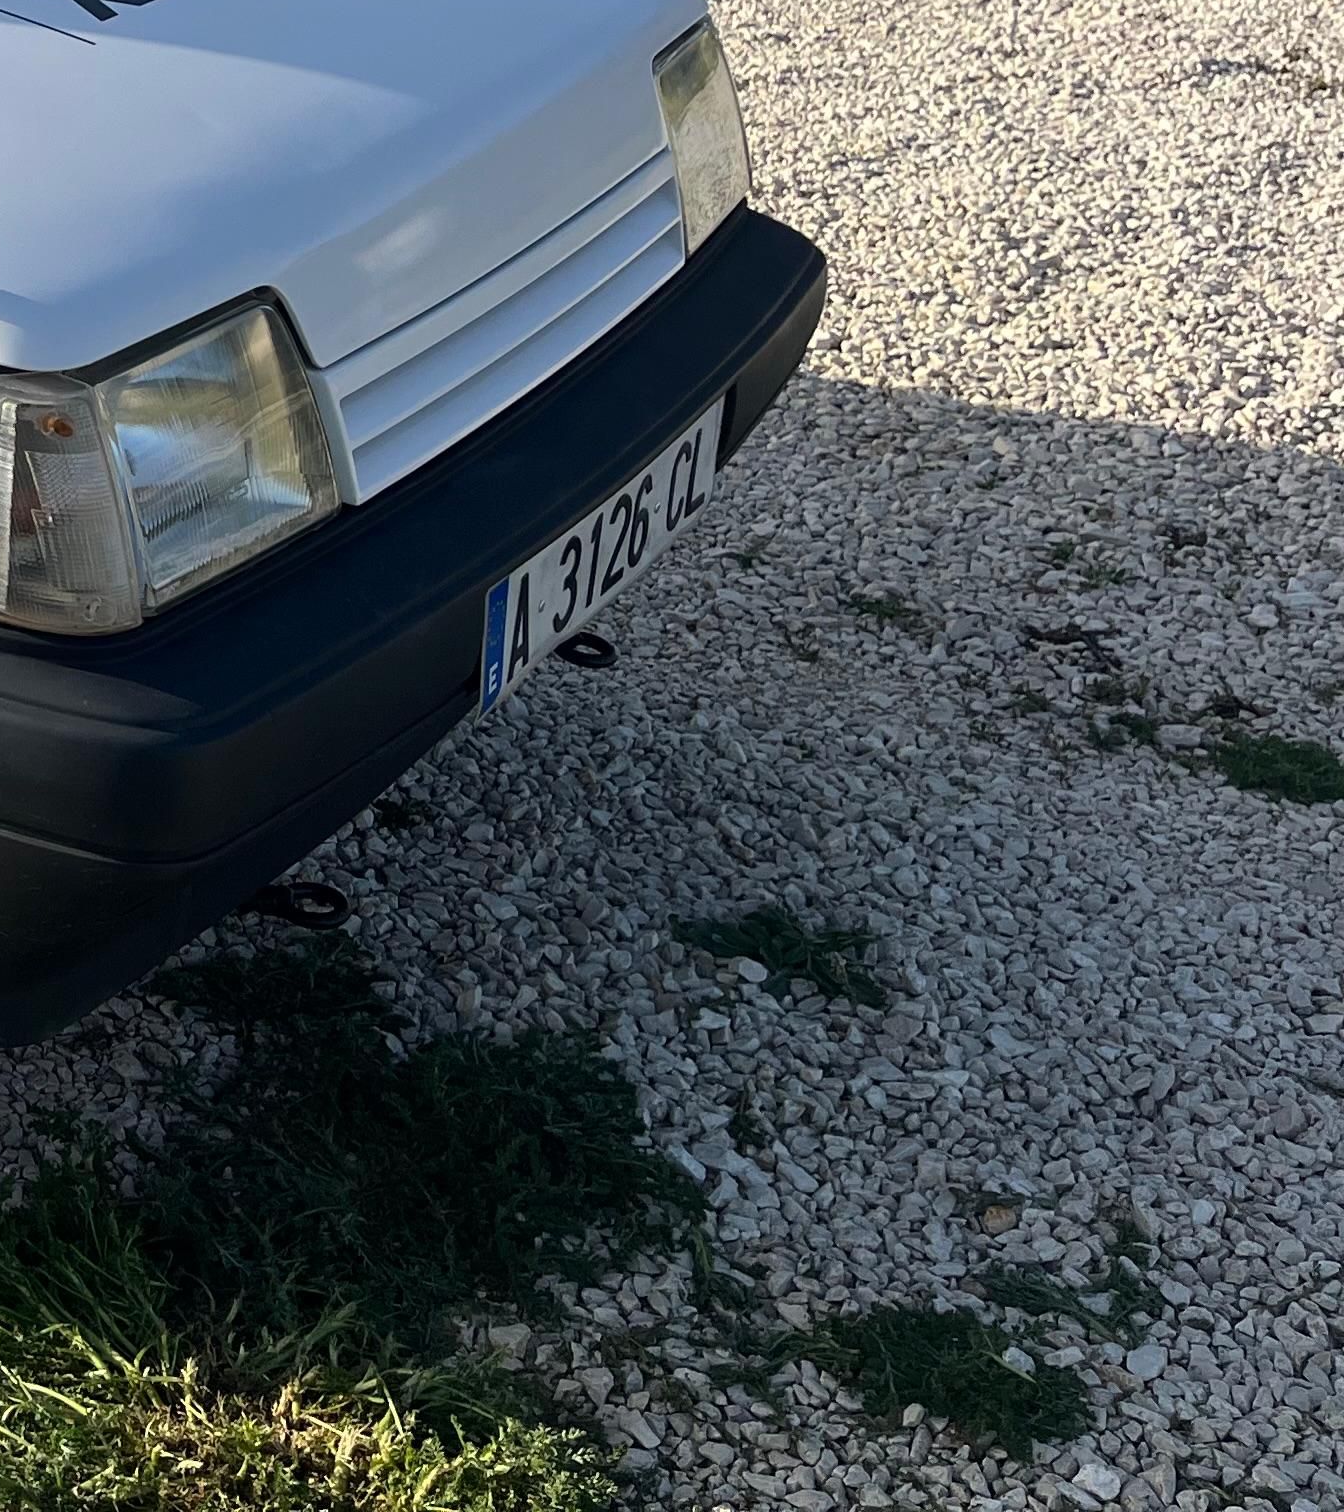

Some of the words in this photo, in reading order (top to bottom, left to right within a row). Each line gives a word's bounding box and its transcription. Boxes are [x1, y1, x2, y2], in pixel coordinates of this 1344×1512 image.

[507, 572, 530, 684] A
[553, 473, 654, 634] 3126
[665, 428, 706, 533] CL
